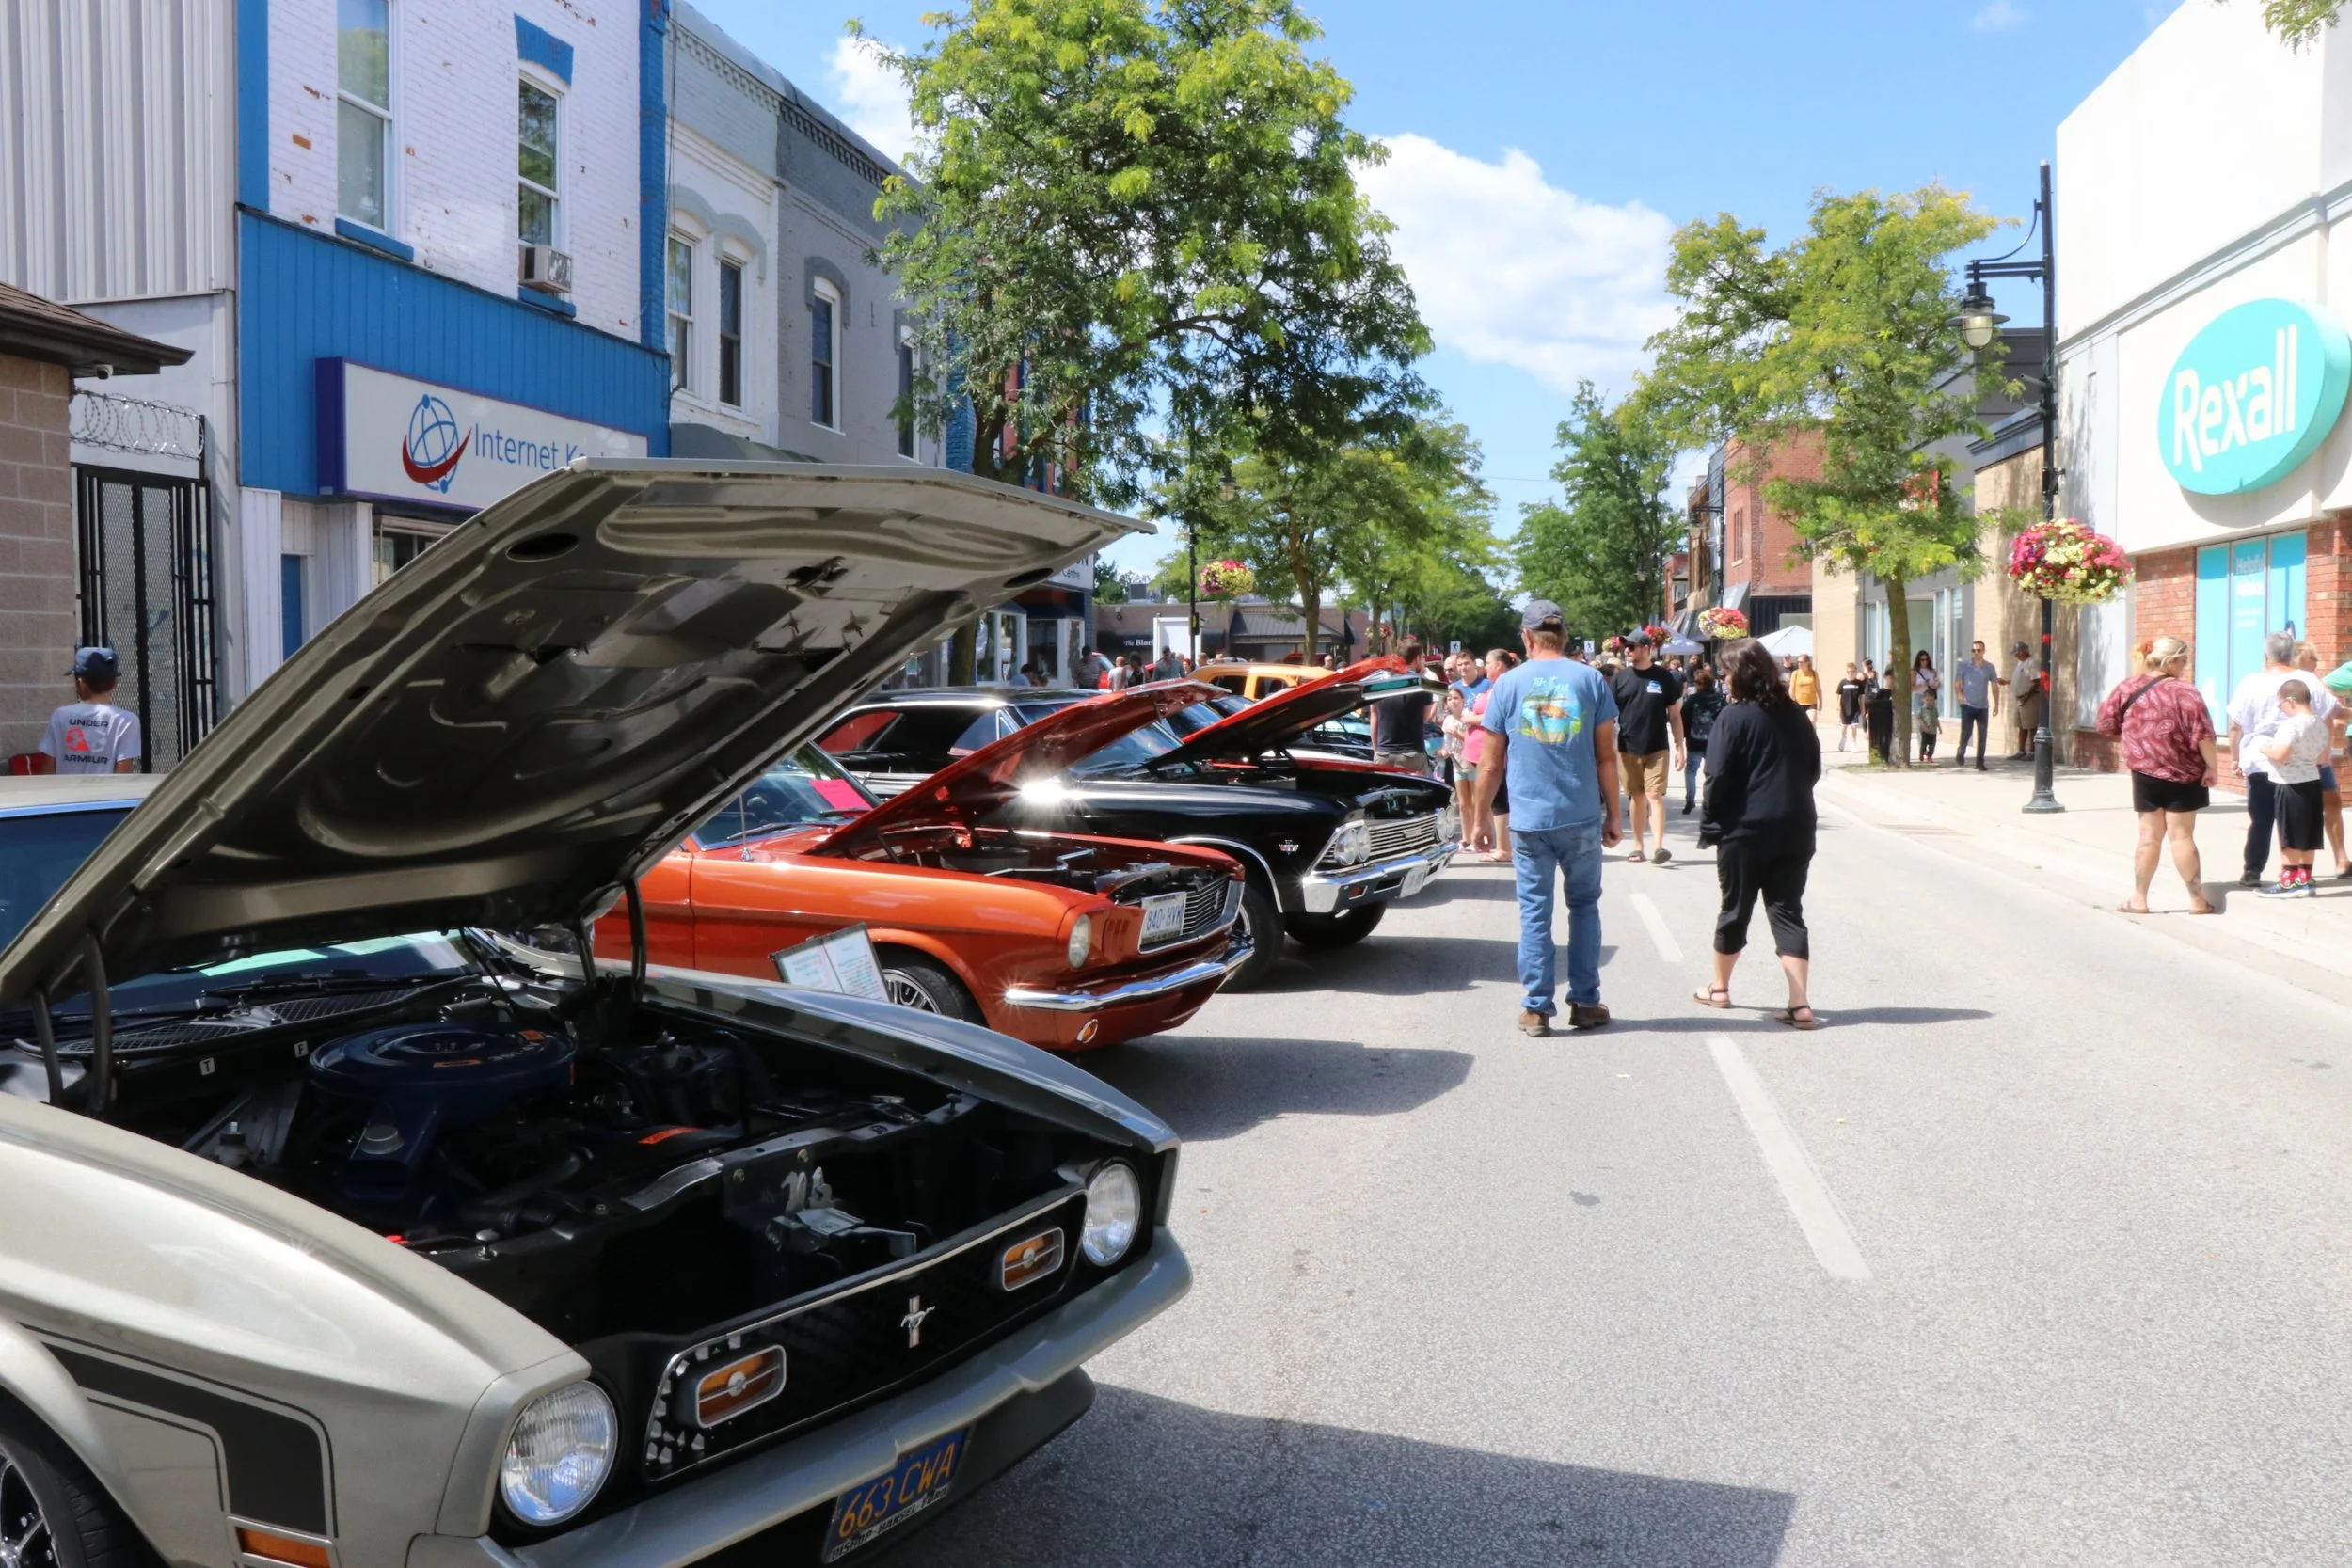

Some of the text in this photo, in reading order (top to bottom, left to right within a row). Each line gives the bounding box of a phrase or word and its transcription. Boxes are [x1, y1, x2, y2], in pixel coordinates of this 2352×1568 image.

[2173, 323, 2298, 473] Rexall
[475, 423, 559, 470] Internet
[69, 718, 109, 728] UNDER
[838, 1443, 956, 1538] 663 CWA
